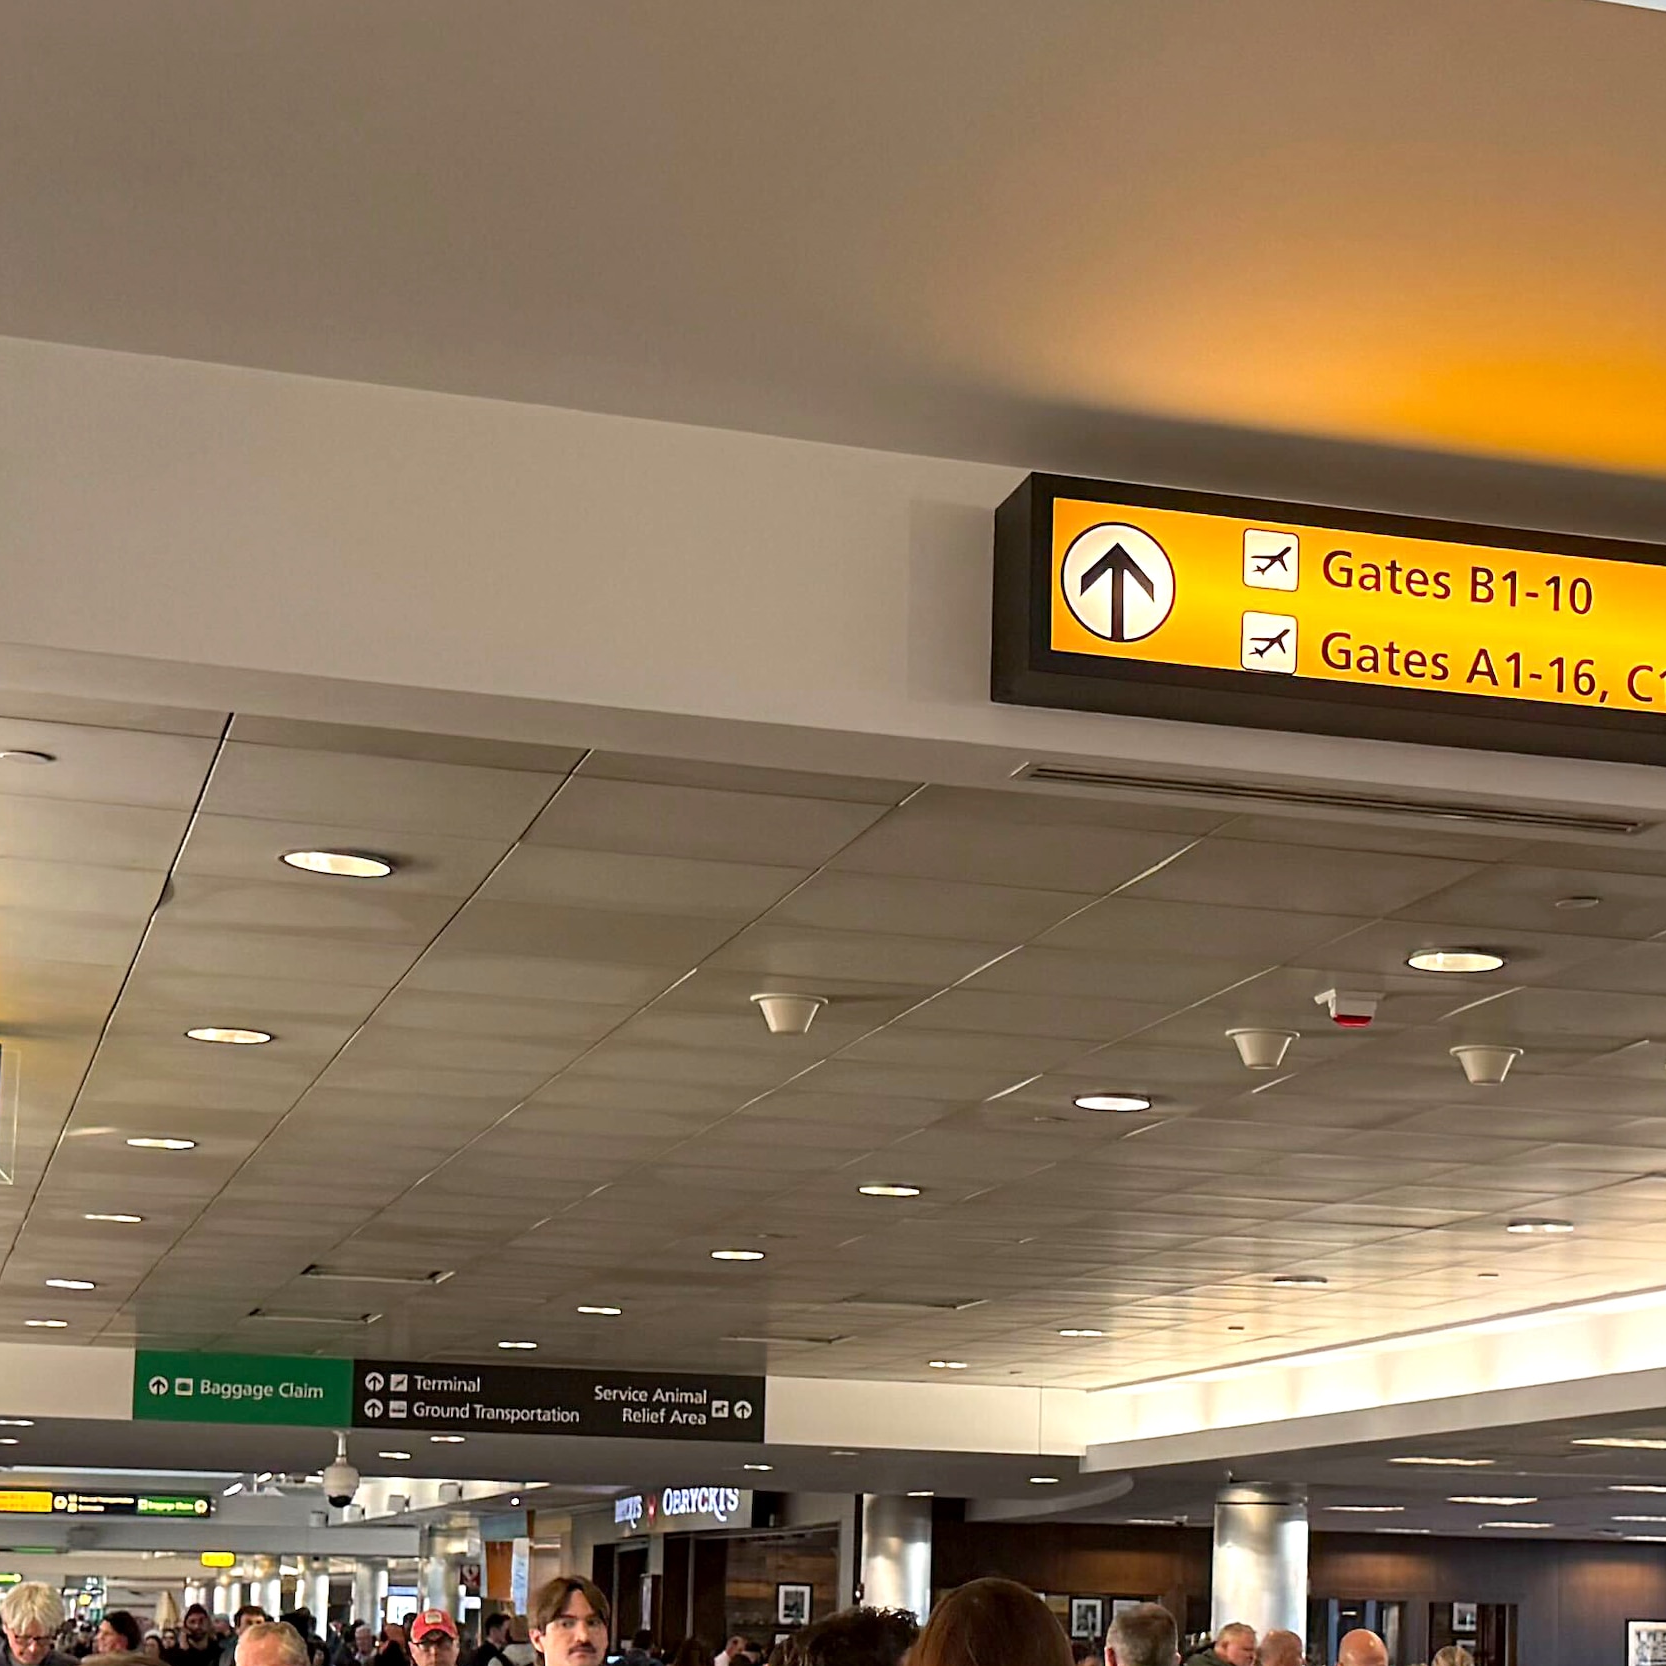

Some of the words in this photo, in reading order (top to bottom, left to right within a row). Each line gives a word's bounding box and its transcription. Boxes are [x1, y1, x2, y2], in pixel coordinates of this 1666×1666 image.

[1321, 550, 1451, 600] Gates
[1469, 566, 1593, 615] B1-10
[1320, 631, 1450, 682] Gates
[1465, 647, 1610, 704] A1-16,
[200, 1379, 274, 1401] Baggage
[278, 1382, 324, 1399] Claim
[413, 1375, 481, 1393] Terminal
[594, 1385, 648, 1402] Service
[652, 1387, 708, 1405] Animal
[413, 1401, 470, 1419] Ground
[472, 1404, 580, 1424] Transportation
[622, 1407, 666, 1424] Relief
[669, 1410, 707, 1425] Area
